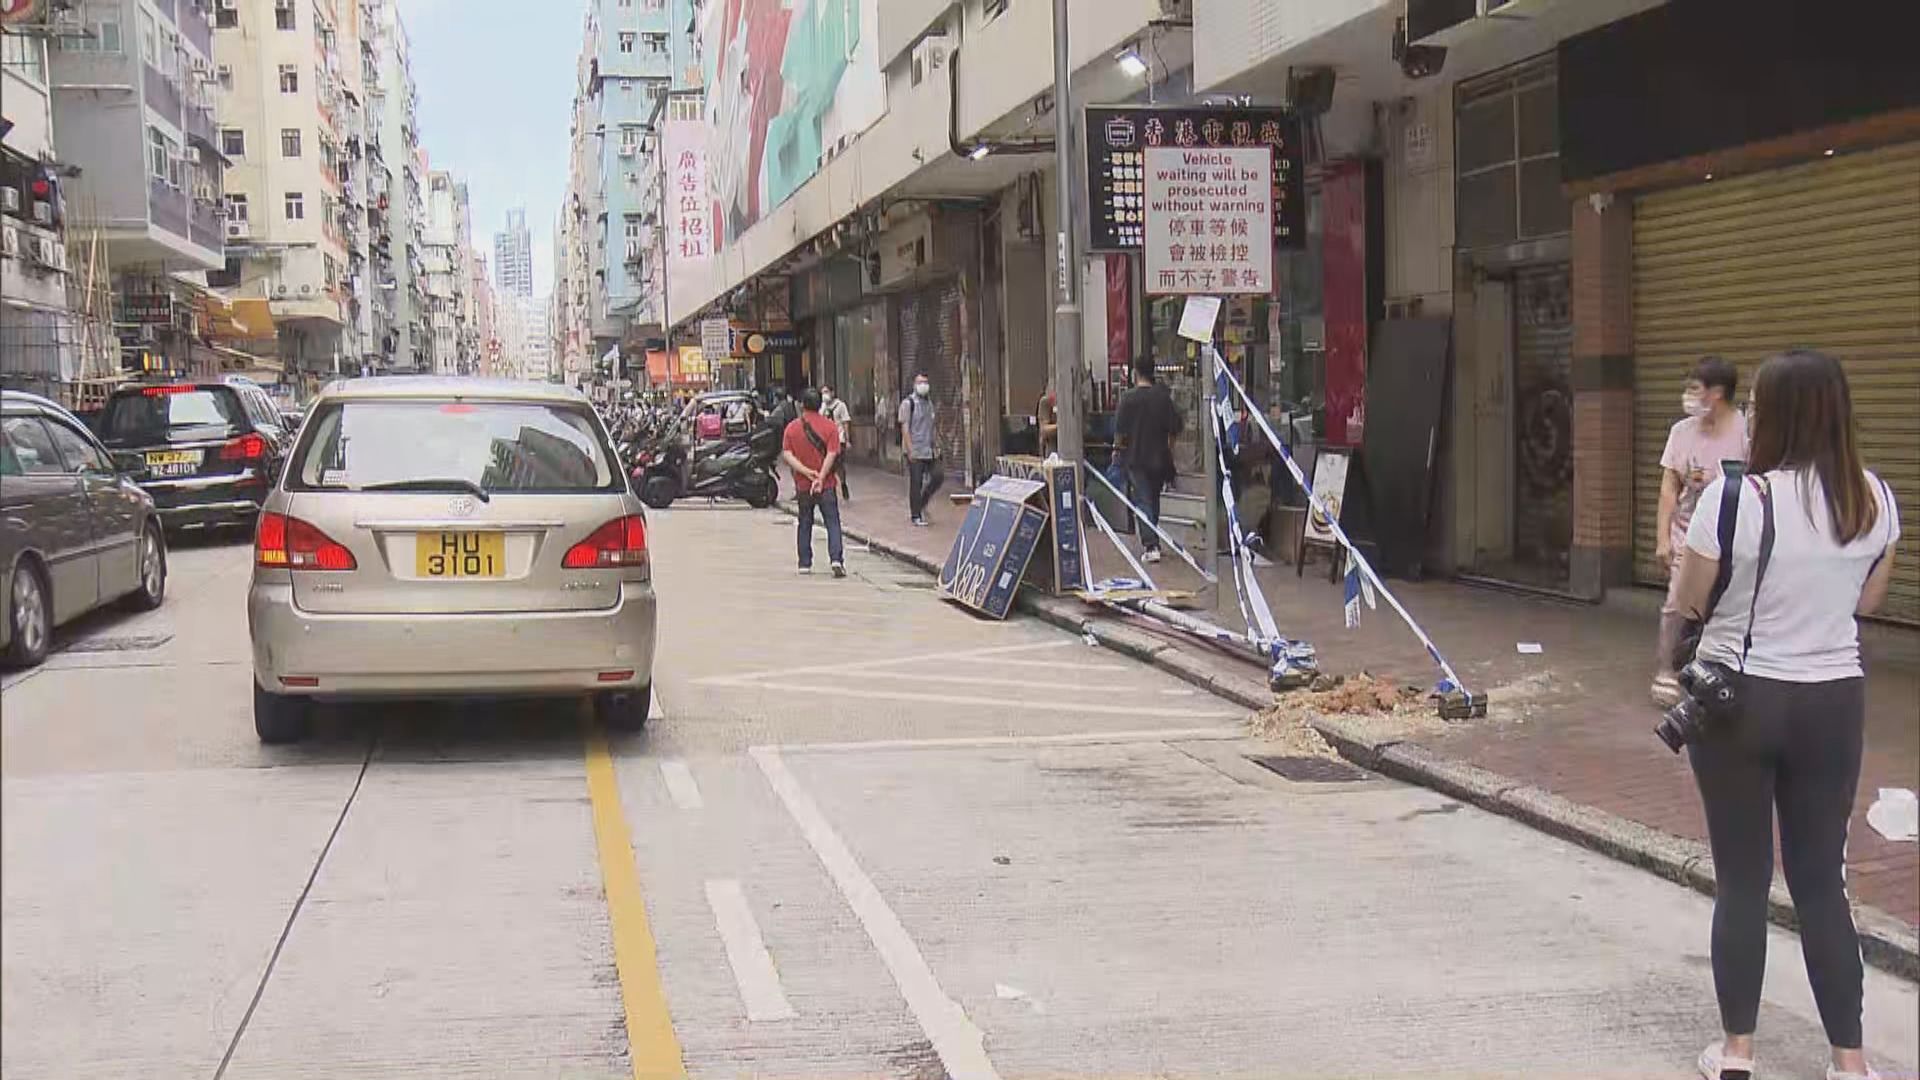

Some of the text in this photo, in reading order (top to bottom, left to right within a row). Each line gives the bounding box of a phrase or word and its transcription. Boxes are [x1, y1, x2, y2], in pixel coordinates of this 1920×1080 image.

[1183, 152, 1232, 165] Vehicle
[1156, 169, 1207, 182] waiting
[1212, 168, 1237, 181] will
[1241, 168, 1259, 181] be
[1168, 184, 1248, 197] prosecuted
[678, 150, 704, 259] 廣告位招租
[1151, 199, 1205, 212] without
[1209, 200, 1265, 213] warning
[1168, 218, 1249, 237] 停車等候
[1168, 242, 1249, 262] 會被檢控
[1158, 268, 1260, 290] 而不予警告
[441, 534, 480, 554] HU
[428, 555, 494, 576] 3101
